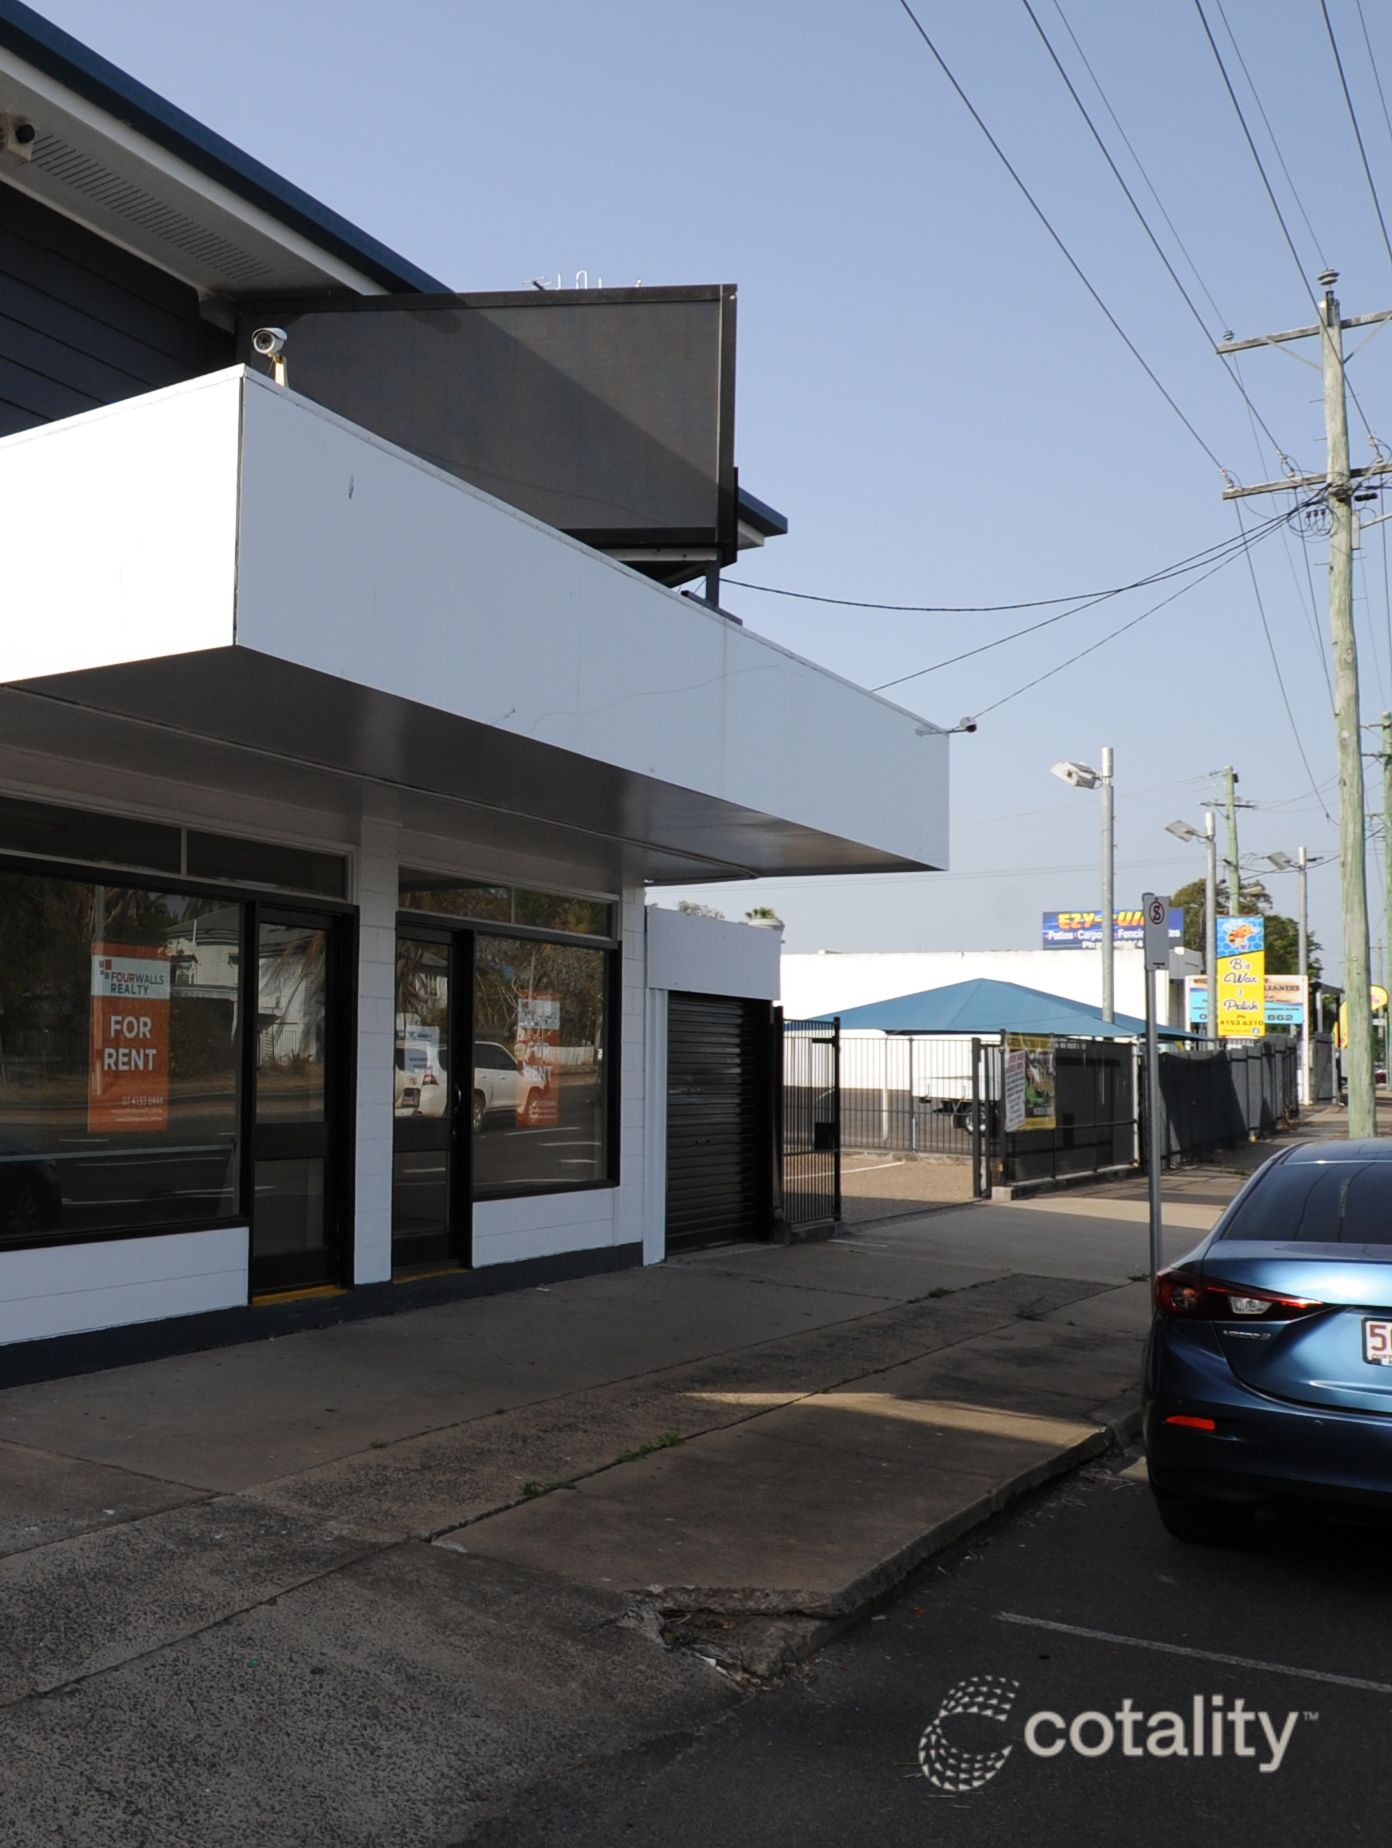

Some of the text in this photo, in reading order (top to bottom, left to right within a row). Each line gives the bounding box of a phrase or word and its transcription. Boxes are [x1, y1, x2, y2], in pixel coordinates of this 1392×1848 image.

[1077, 929, 1103, 941] Carpo
[110, 971, 165, 985] FOURWALLS
[1224, 972, 1257, 983] Wax
[110, 983, 150, 995] REALTY
[1223, 999, 1258, 1011] Polish
[110, 1016, 152, 1039] FOR
[104, 1048, 157, 1071] RENT
[1370, 1324, 1392, 1351] 5
